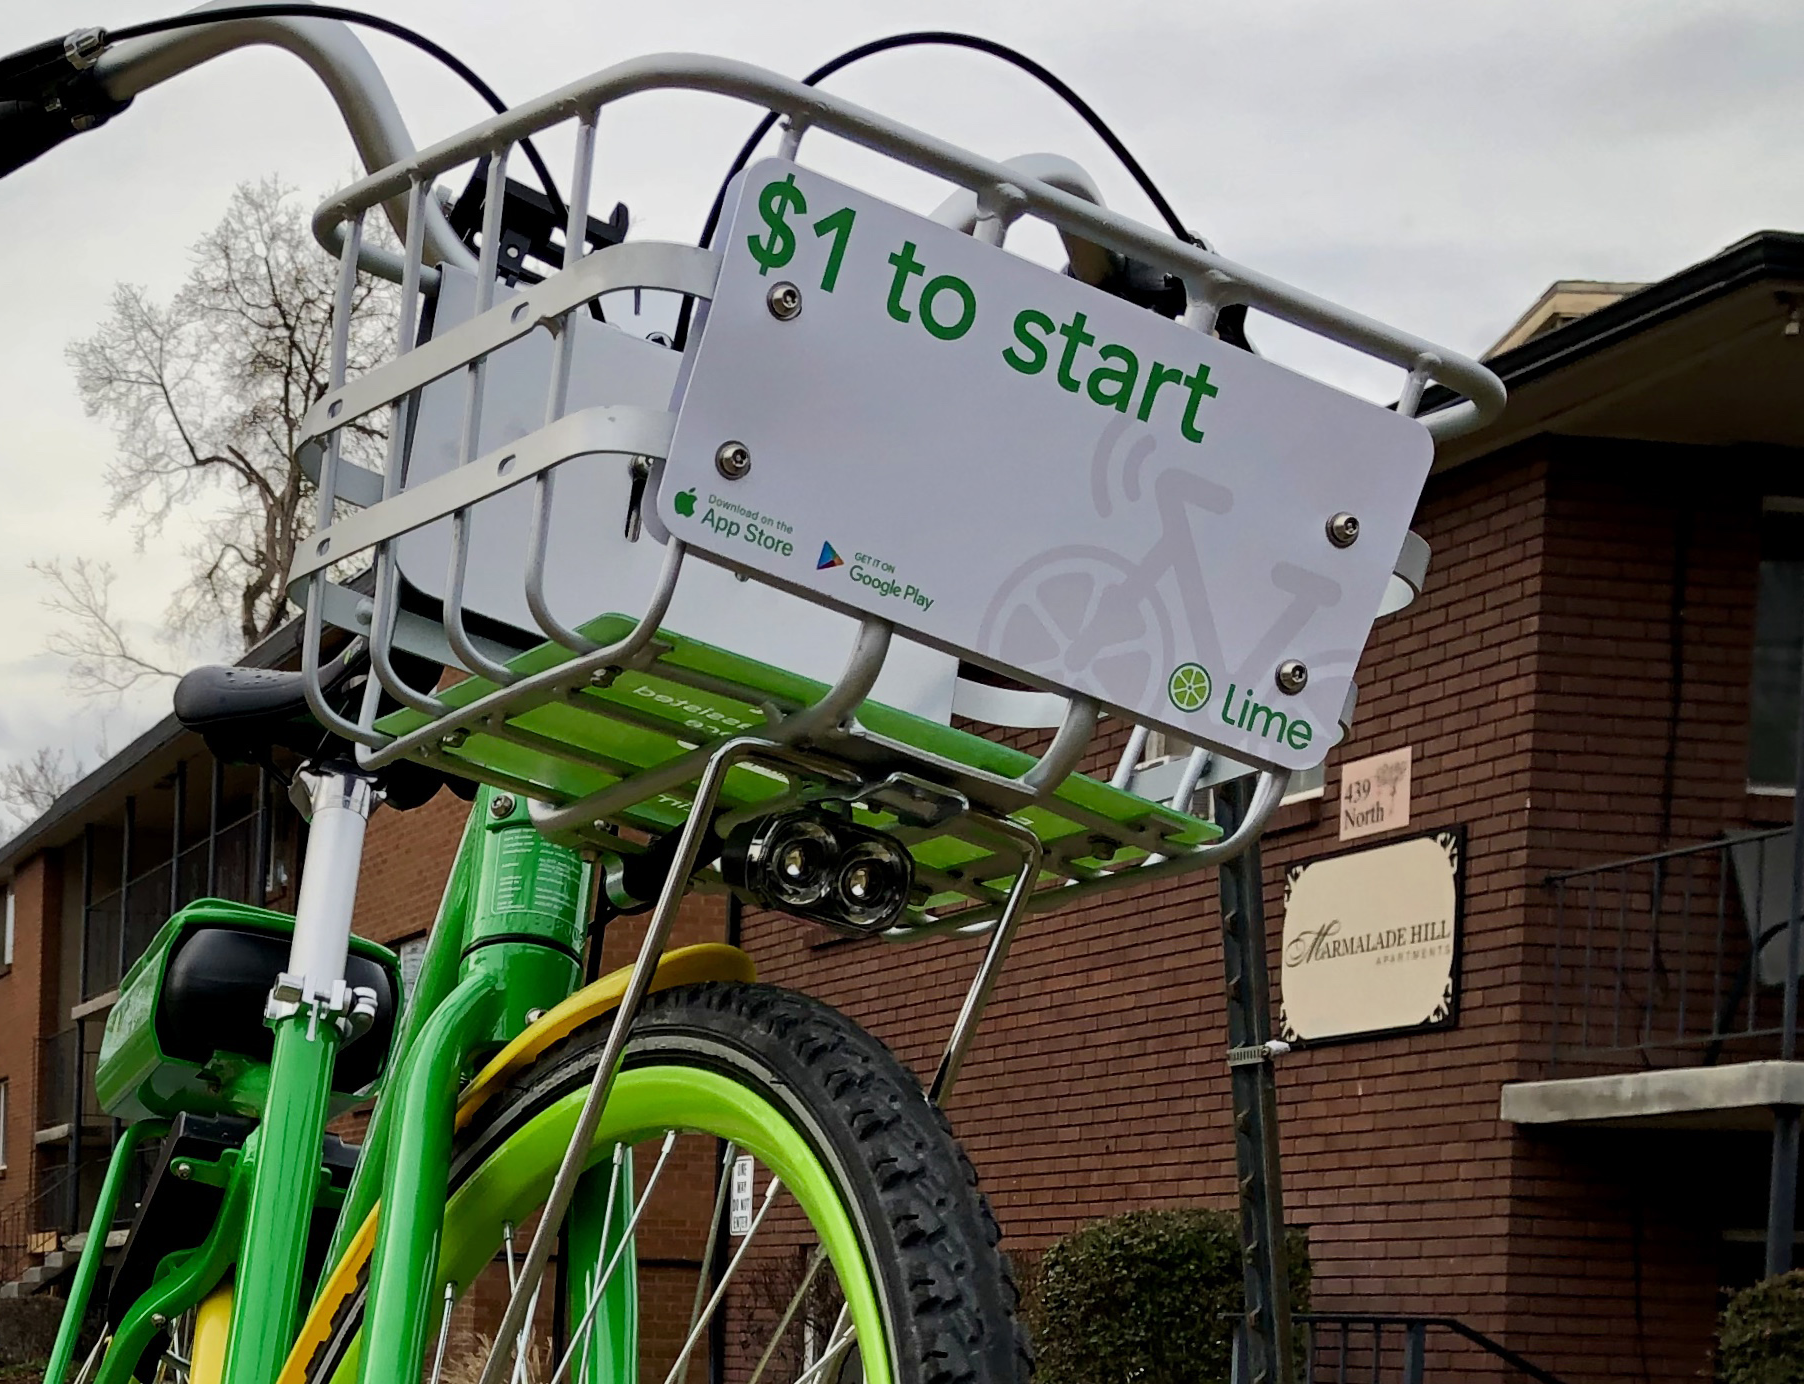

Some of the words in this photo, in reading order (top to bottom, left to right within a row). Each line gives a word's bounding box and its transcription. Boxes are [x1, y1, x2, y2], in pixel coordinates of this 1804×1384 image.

[747, 173, 857, 293] $1
[886, 241, 976, 340] to
[1001, 308, 1219, 444] start
[707, 493, 760, 522] Download
[760, 514, 774, 528] on
[776, 518, 793, 535] the
[701, 508, 740, 538] App
[743, 523, 793, 557] Store
[854, 552, 873, 566] GET
[872, 556, 880, 568] IT
[881, 561, 896, 574] ON
[849, 564, 902, 598] Google
[903, 584, 934, 612] Play
[1221, 683, 1313, 750] Lime
[1344, 778, 1372, 804] 439
[1344, 801, 1385, 831] North
[1410, 919, 1452, 945] HILL
[1375, 945, 1452, 966] APARTMENTS
